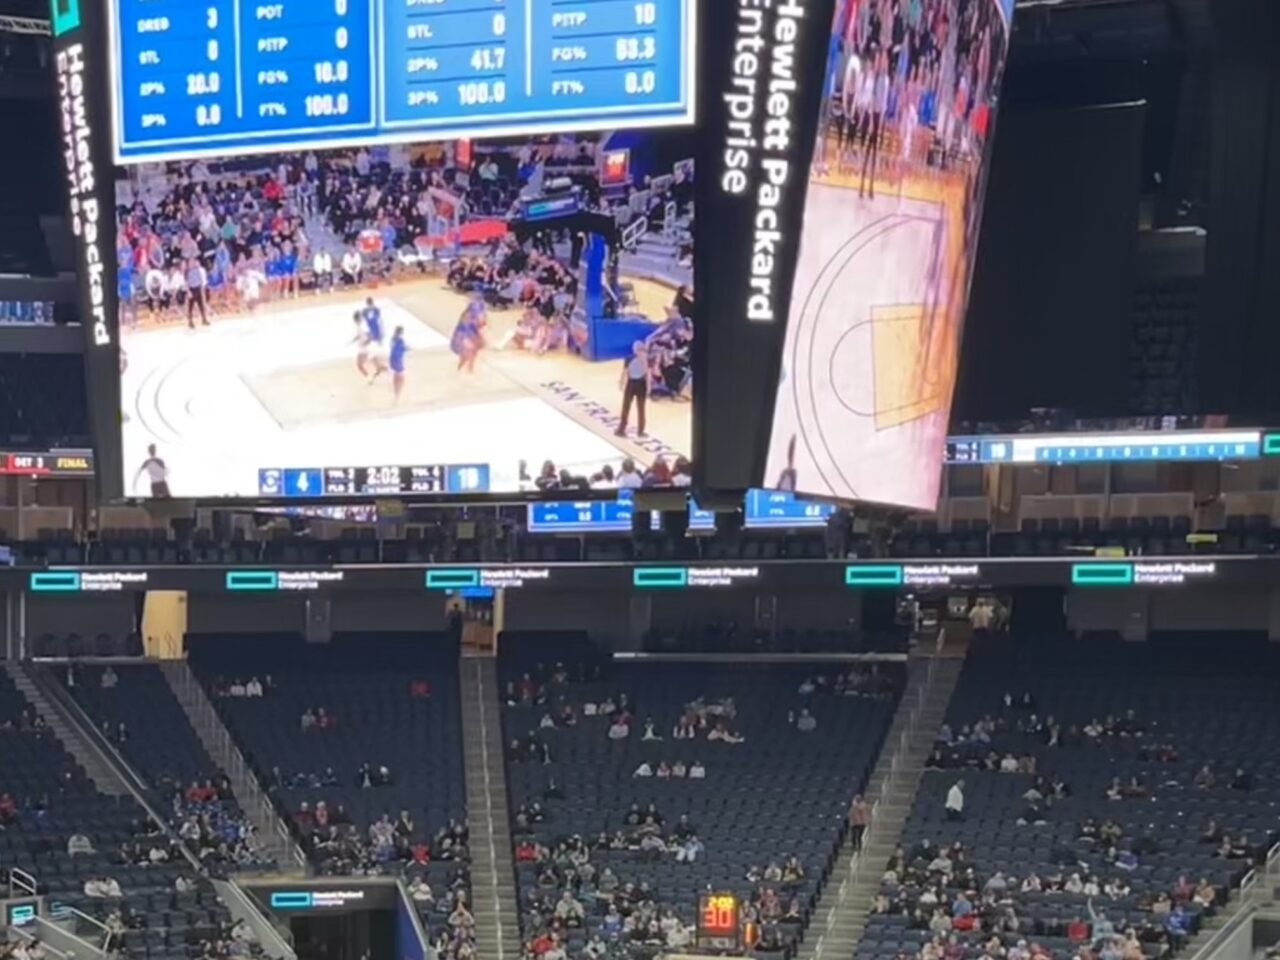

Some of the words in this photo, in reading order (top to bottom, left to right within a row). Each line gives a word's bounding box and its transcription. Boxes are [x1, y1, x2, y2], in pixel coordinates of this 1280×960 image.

[207, 7, 218, 28] 3
[634, 3, 656, 25] 10
[407, 25, 433, 39] STL
[493, 14, 505, 35] 0
[335, 27, 348, 49] 0
[207, 39, 218, 61] 0
[471, 48, 505, 70] 41.7
[762, 0, 805, 151] Hewlett
[552, 80, 584, 96] FT%
[305, 93, 349, 117] 100.0
[67, 43, 96, 192] Hewlett
[56, 51, 81, 236] Enterprise
[746, 159, 789, 321] Packard
[81, 198, 110, 346] Packard
[57, 456, 88, 469] FINAL
[296, 472, 309, 492] 4
[367, 467, 400, 485] 2:02
